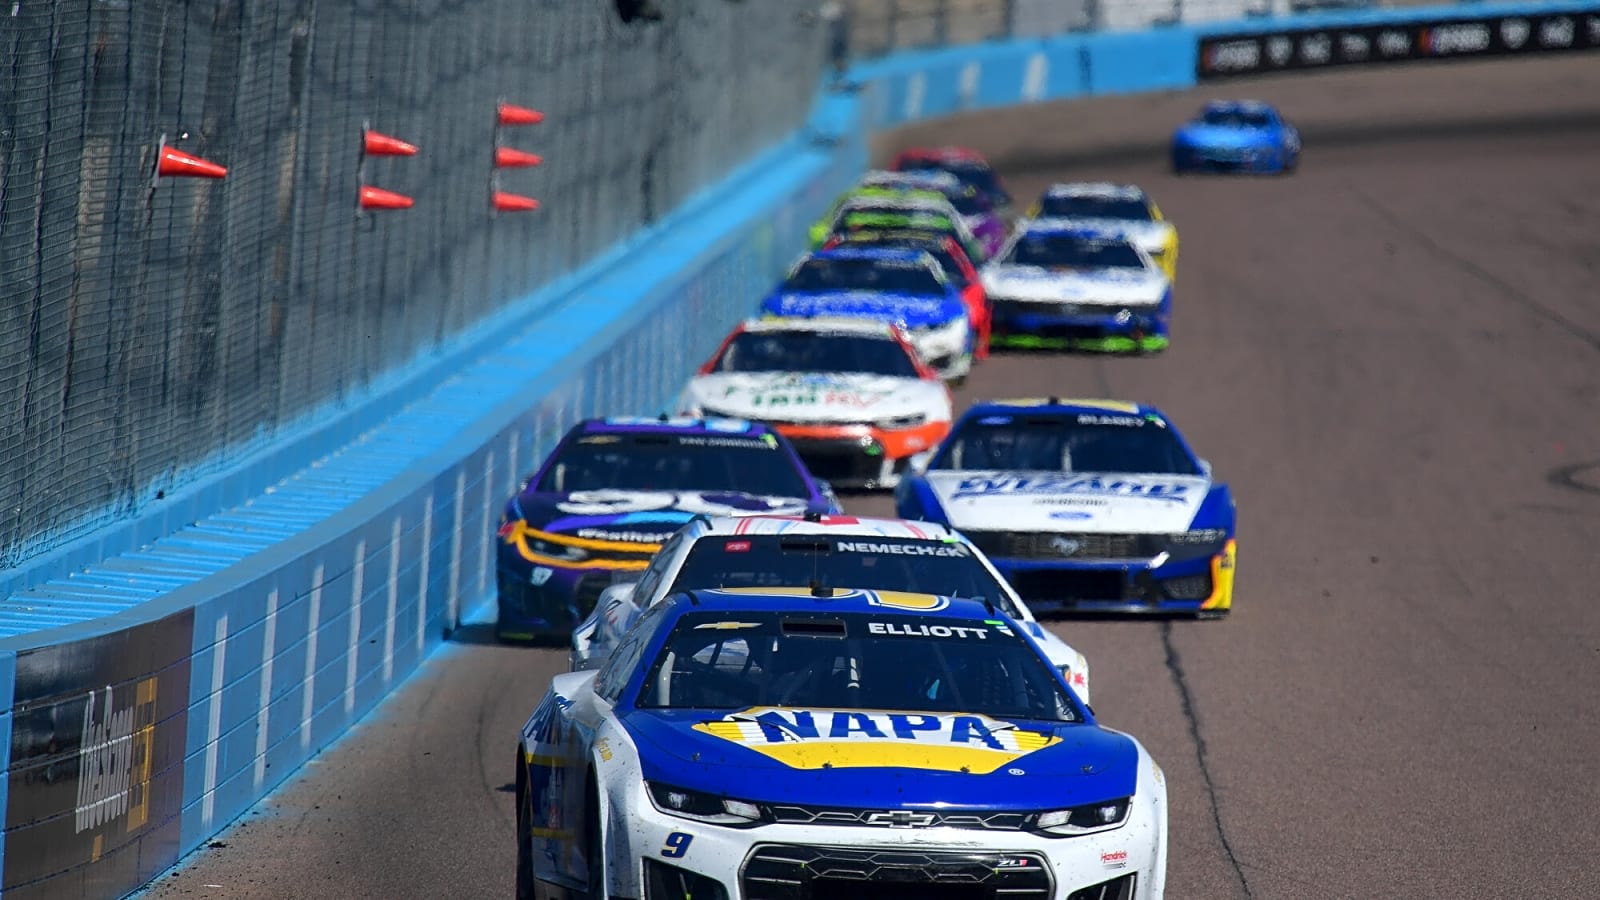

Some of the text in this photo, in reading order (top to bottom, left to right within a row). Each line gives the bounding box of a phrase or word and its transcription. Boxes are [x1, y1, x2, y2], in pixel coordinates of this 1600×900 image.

[837, 541, 965, 558] NEMECHEK
[868, 622, 988, 640] ELLIOTT
[757, 710, 1006, 751] NAPA
[660, 831, 694, 858] 9
[996, 858, 1028, 867] ZL1
